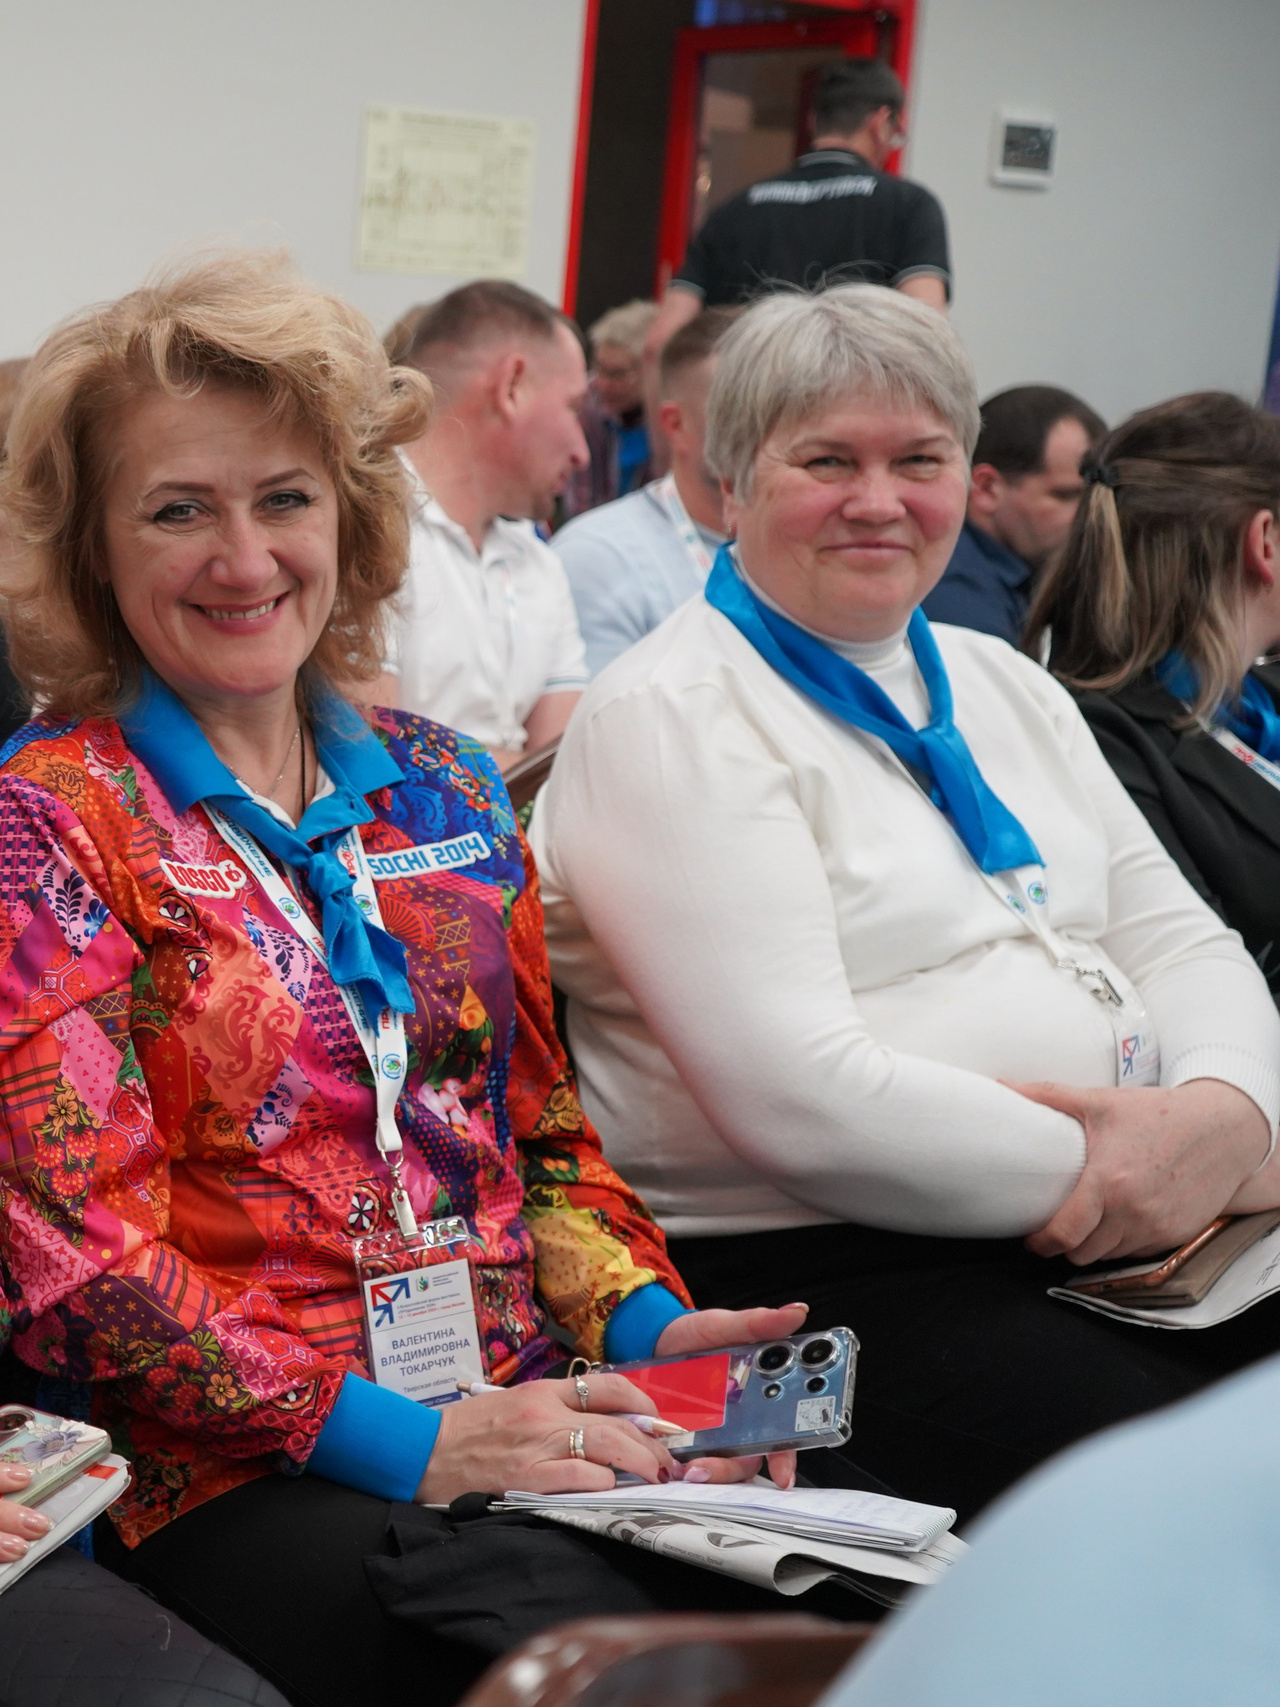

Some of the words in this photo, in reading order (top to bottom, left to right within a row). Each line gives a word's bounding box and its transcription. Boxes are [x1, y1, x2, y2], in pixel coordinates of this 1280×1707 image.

[219, 812, 274, 877] ДВИЖЕНИЕ
[366, 850, 432, 875] SOCHI
[431, 837, 486, 865] 2014
[165, 862, 231, 893] BOSCO
[381, 1338, 471, 1367] ВЛАДИМИРОВНА
[392, 1327, 456, 1350] ВАЛЕНТИНА
[400, 1355, 457, 1377] ТОКАРЧУК
